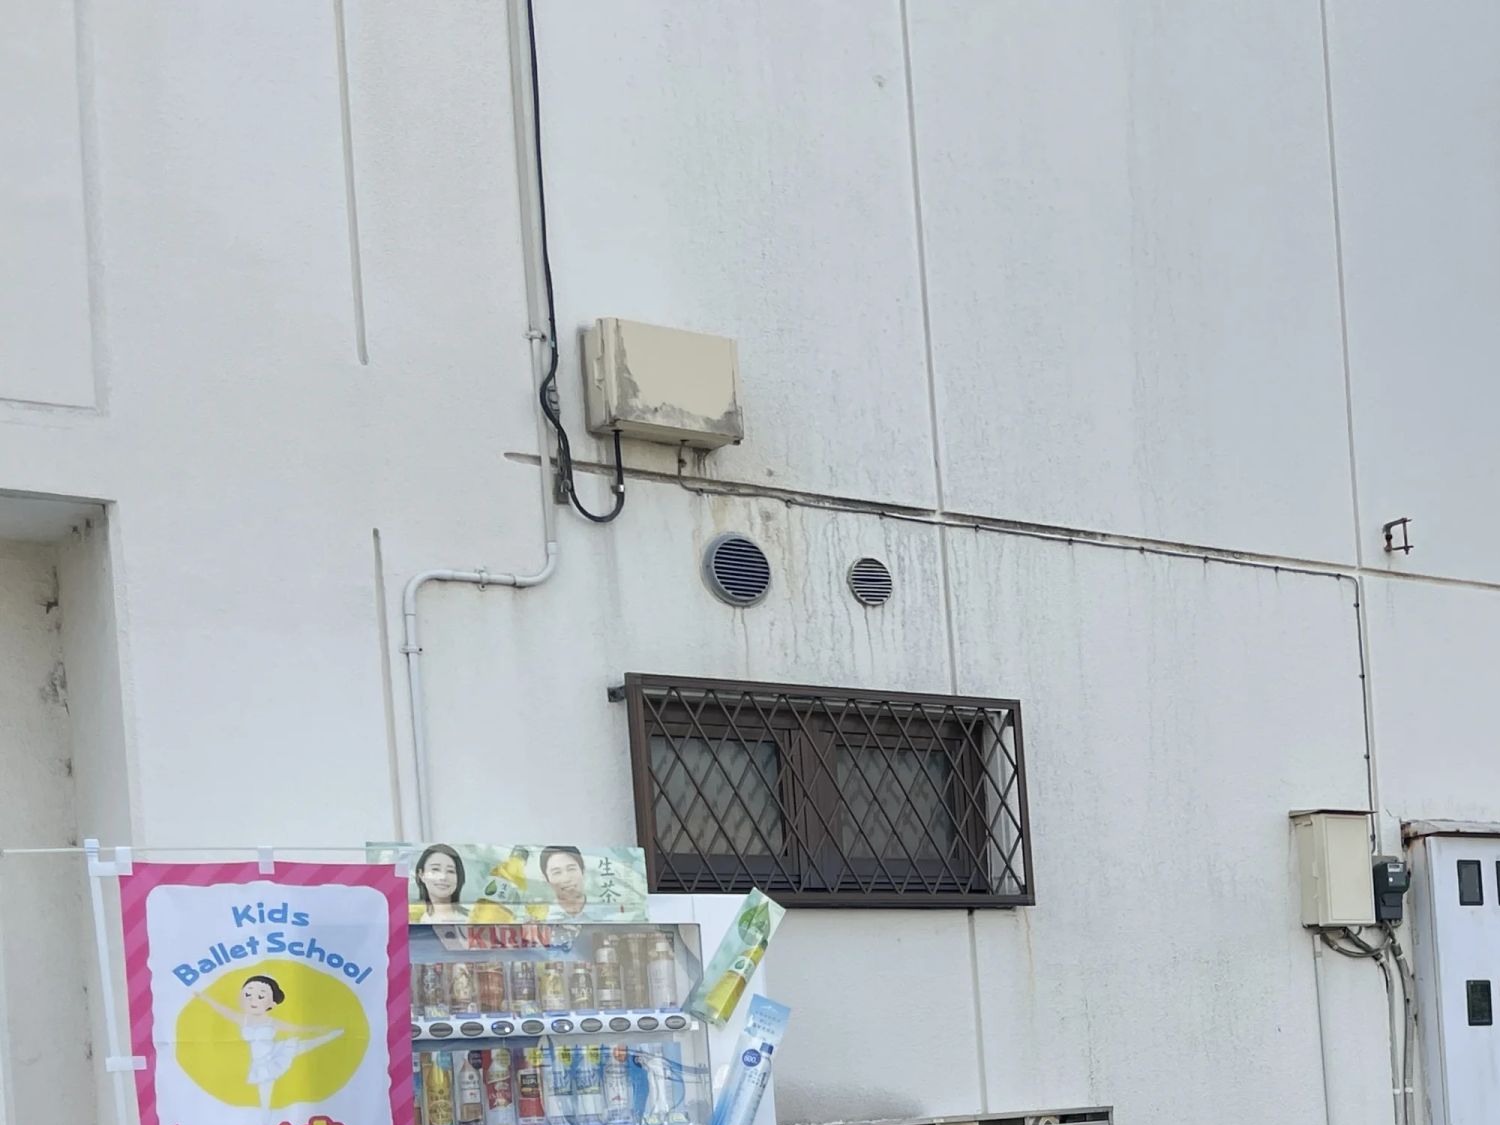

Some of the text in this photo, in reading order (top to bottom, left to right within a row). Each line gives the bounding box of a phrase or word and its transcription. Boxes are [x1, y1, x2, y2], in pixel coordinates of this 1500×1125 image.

[598, 856, 621, 902] 生茶
[231, 902, 310, 928] Kids
[467, 924, 549, 949] KIRIN
[172, 932, 373, 987] Ballet School
